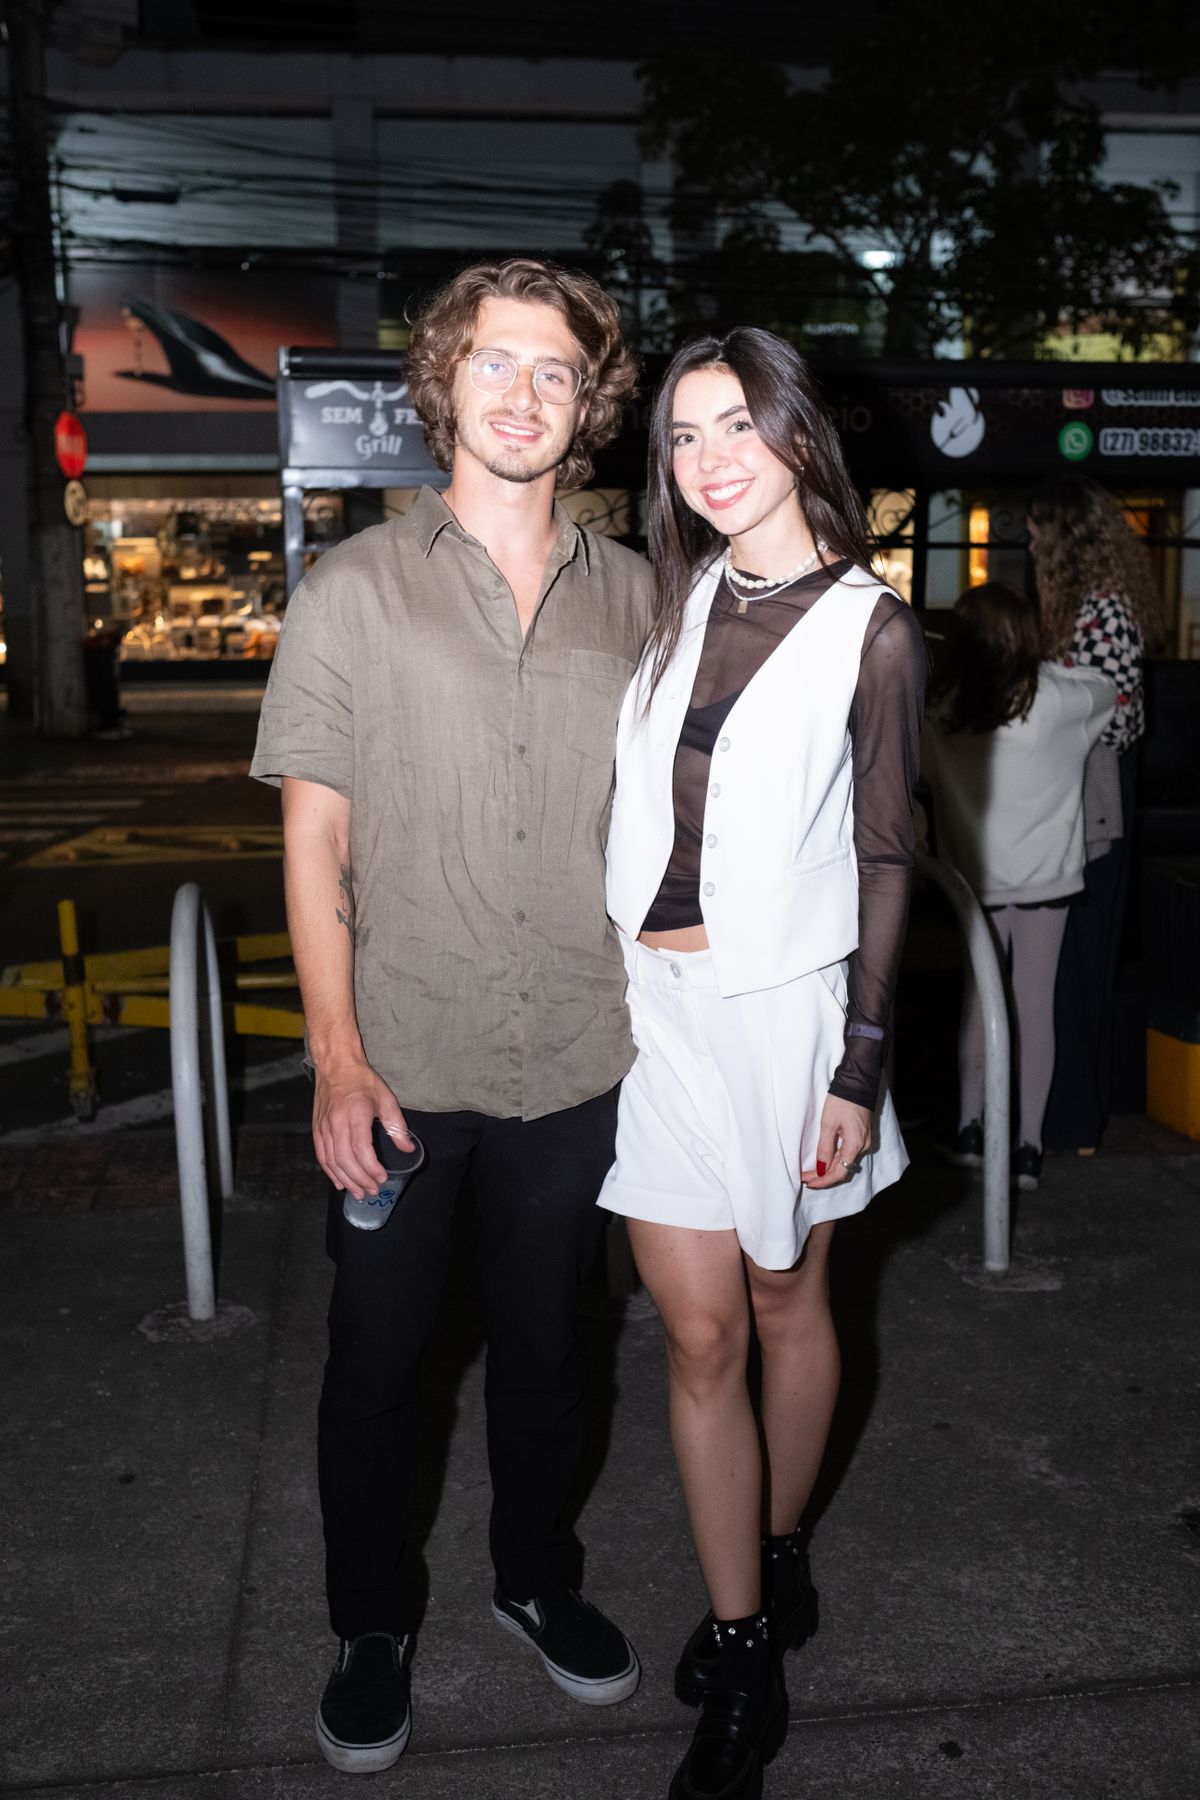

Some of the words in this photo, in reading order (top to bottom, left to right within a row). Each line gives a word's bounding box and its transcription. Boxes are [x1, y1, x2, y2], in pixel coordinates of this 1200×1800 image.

[320, 406, 363, 425] SEM
[355, 434, 403, 460] Grill
[1102, 432, 1135, 453] (27)
